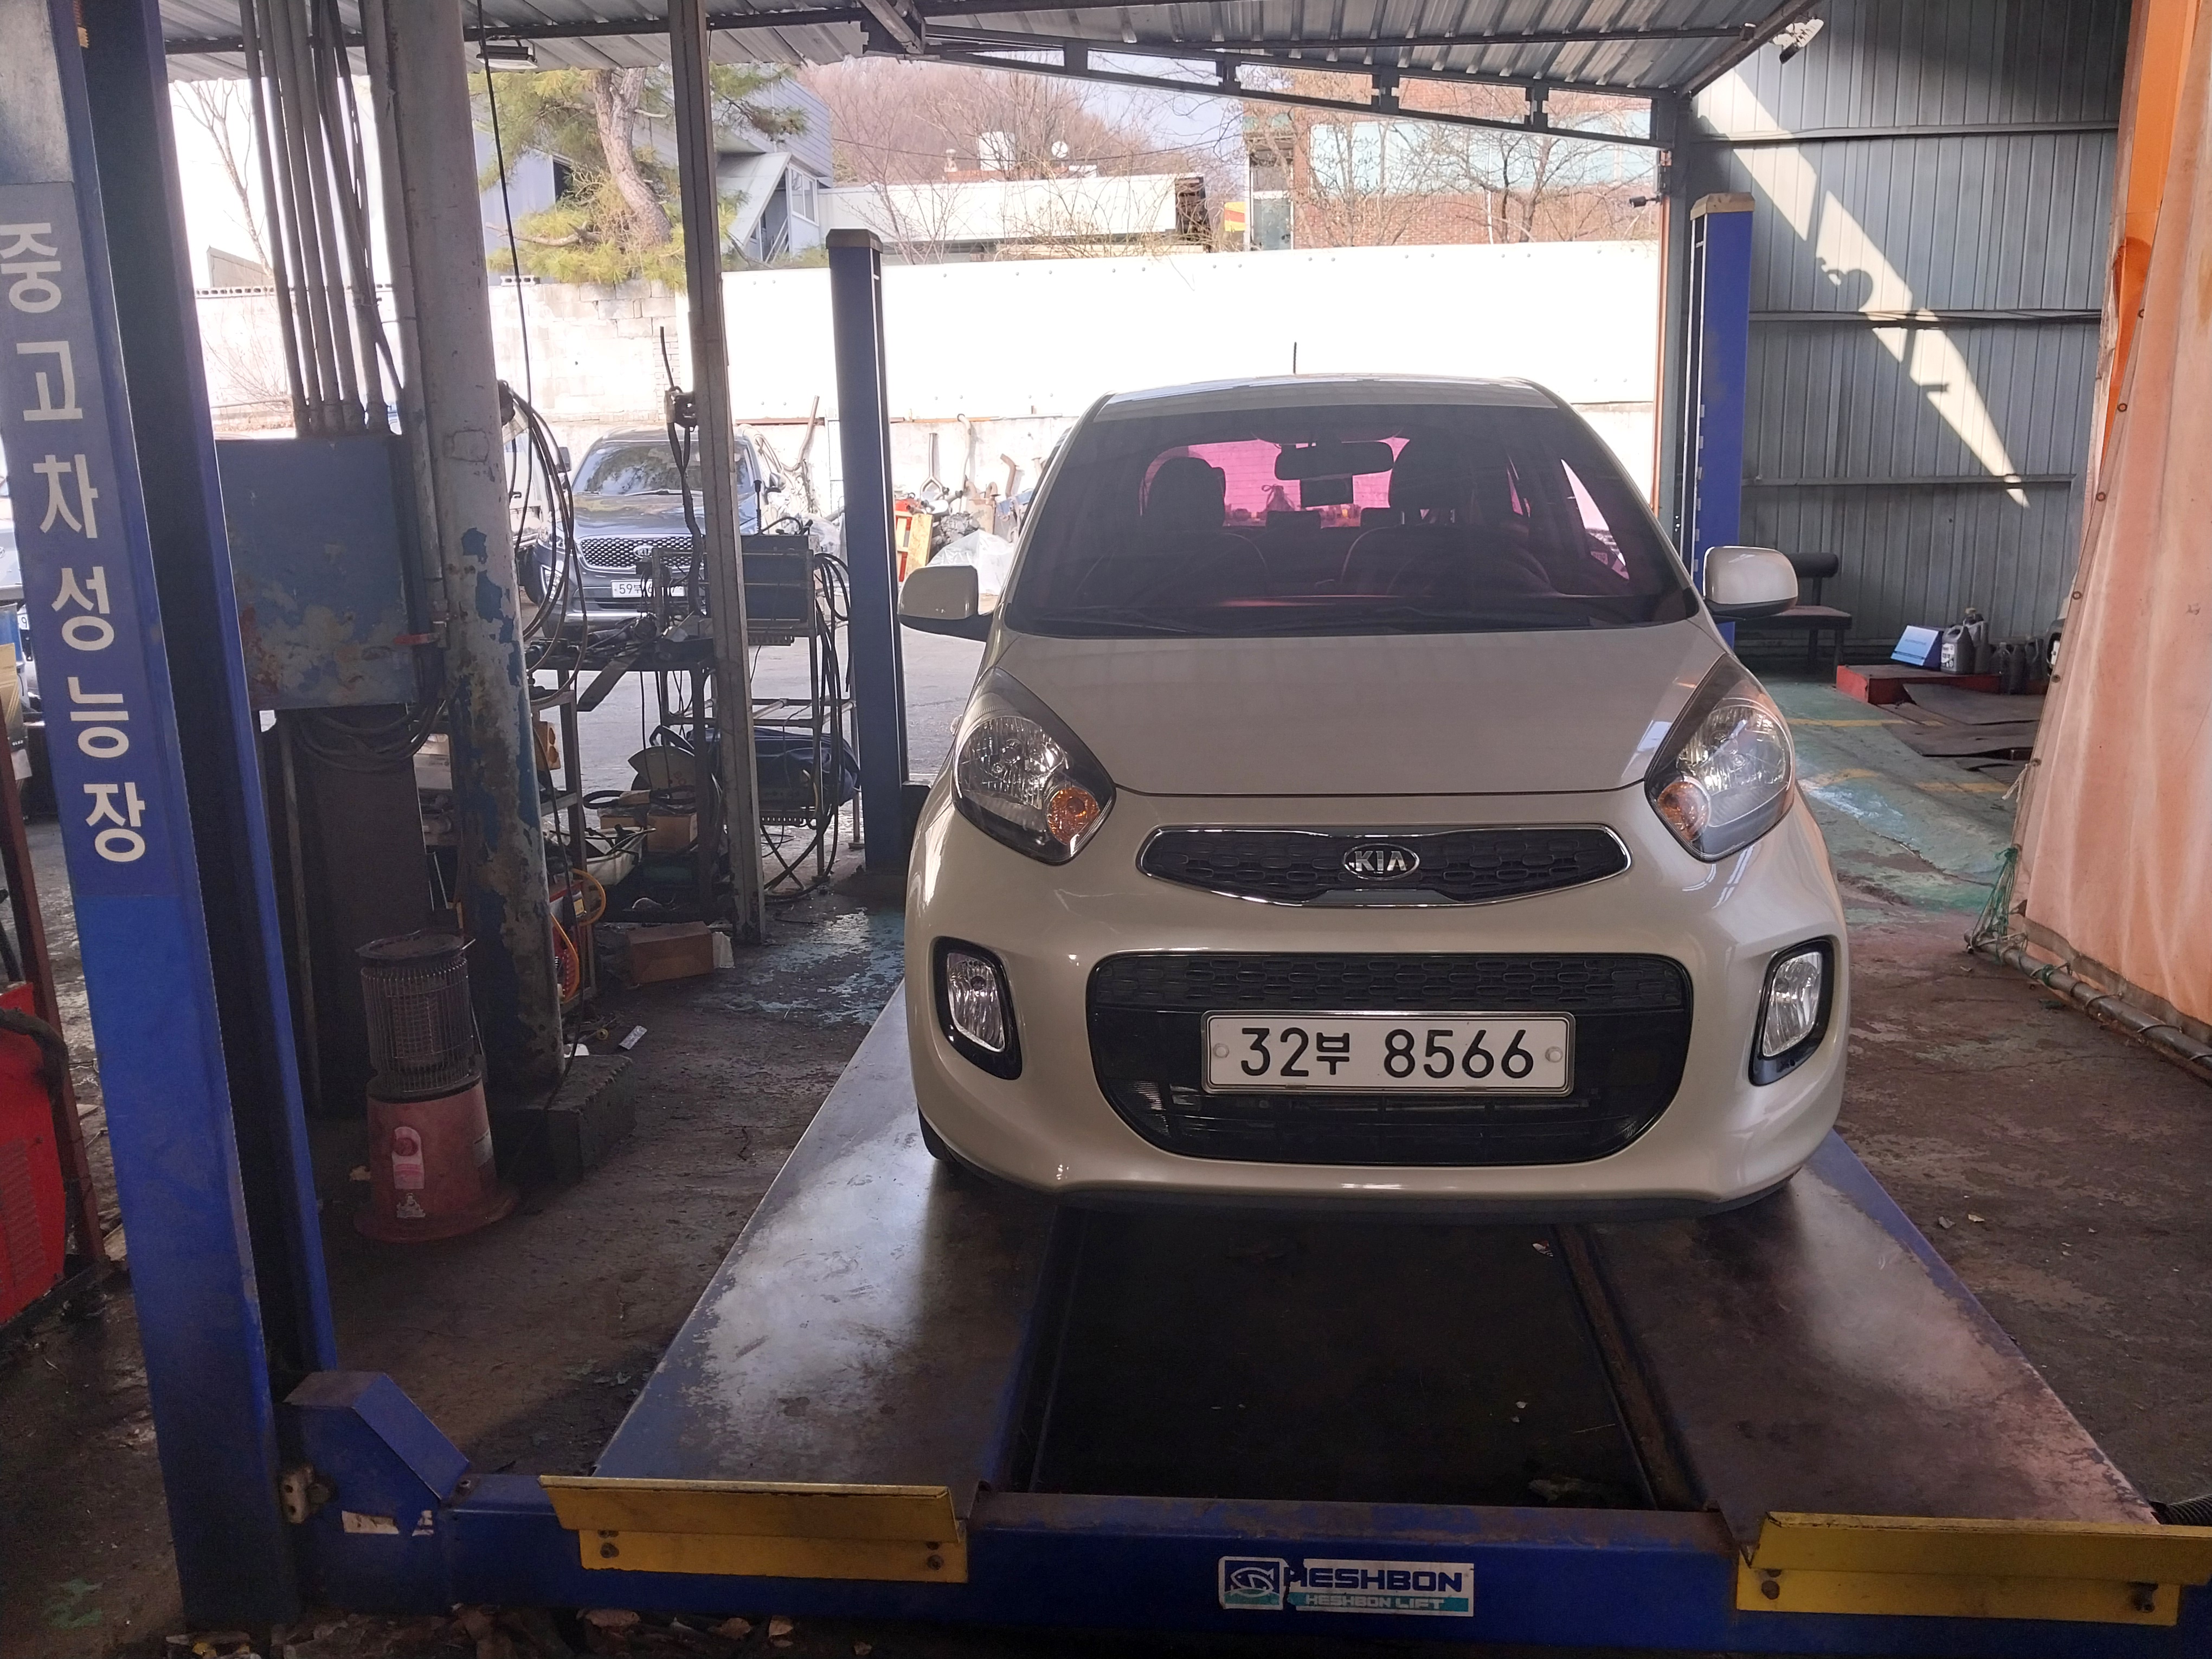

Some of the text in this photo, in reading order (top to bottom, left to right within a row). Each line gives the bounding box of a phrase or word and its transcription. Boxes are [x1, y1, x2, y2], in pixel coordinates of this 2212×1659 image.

[1354, 850, 1407, 872] KIA
[1240, 1027, 1534, 1079] 32부 8566
[1283, 1567, 1462, 1592] HESHBON
[1306, 1593, 1444, 1609] HESHBON LIFT
